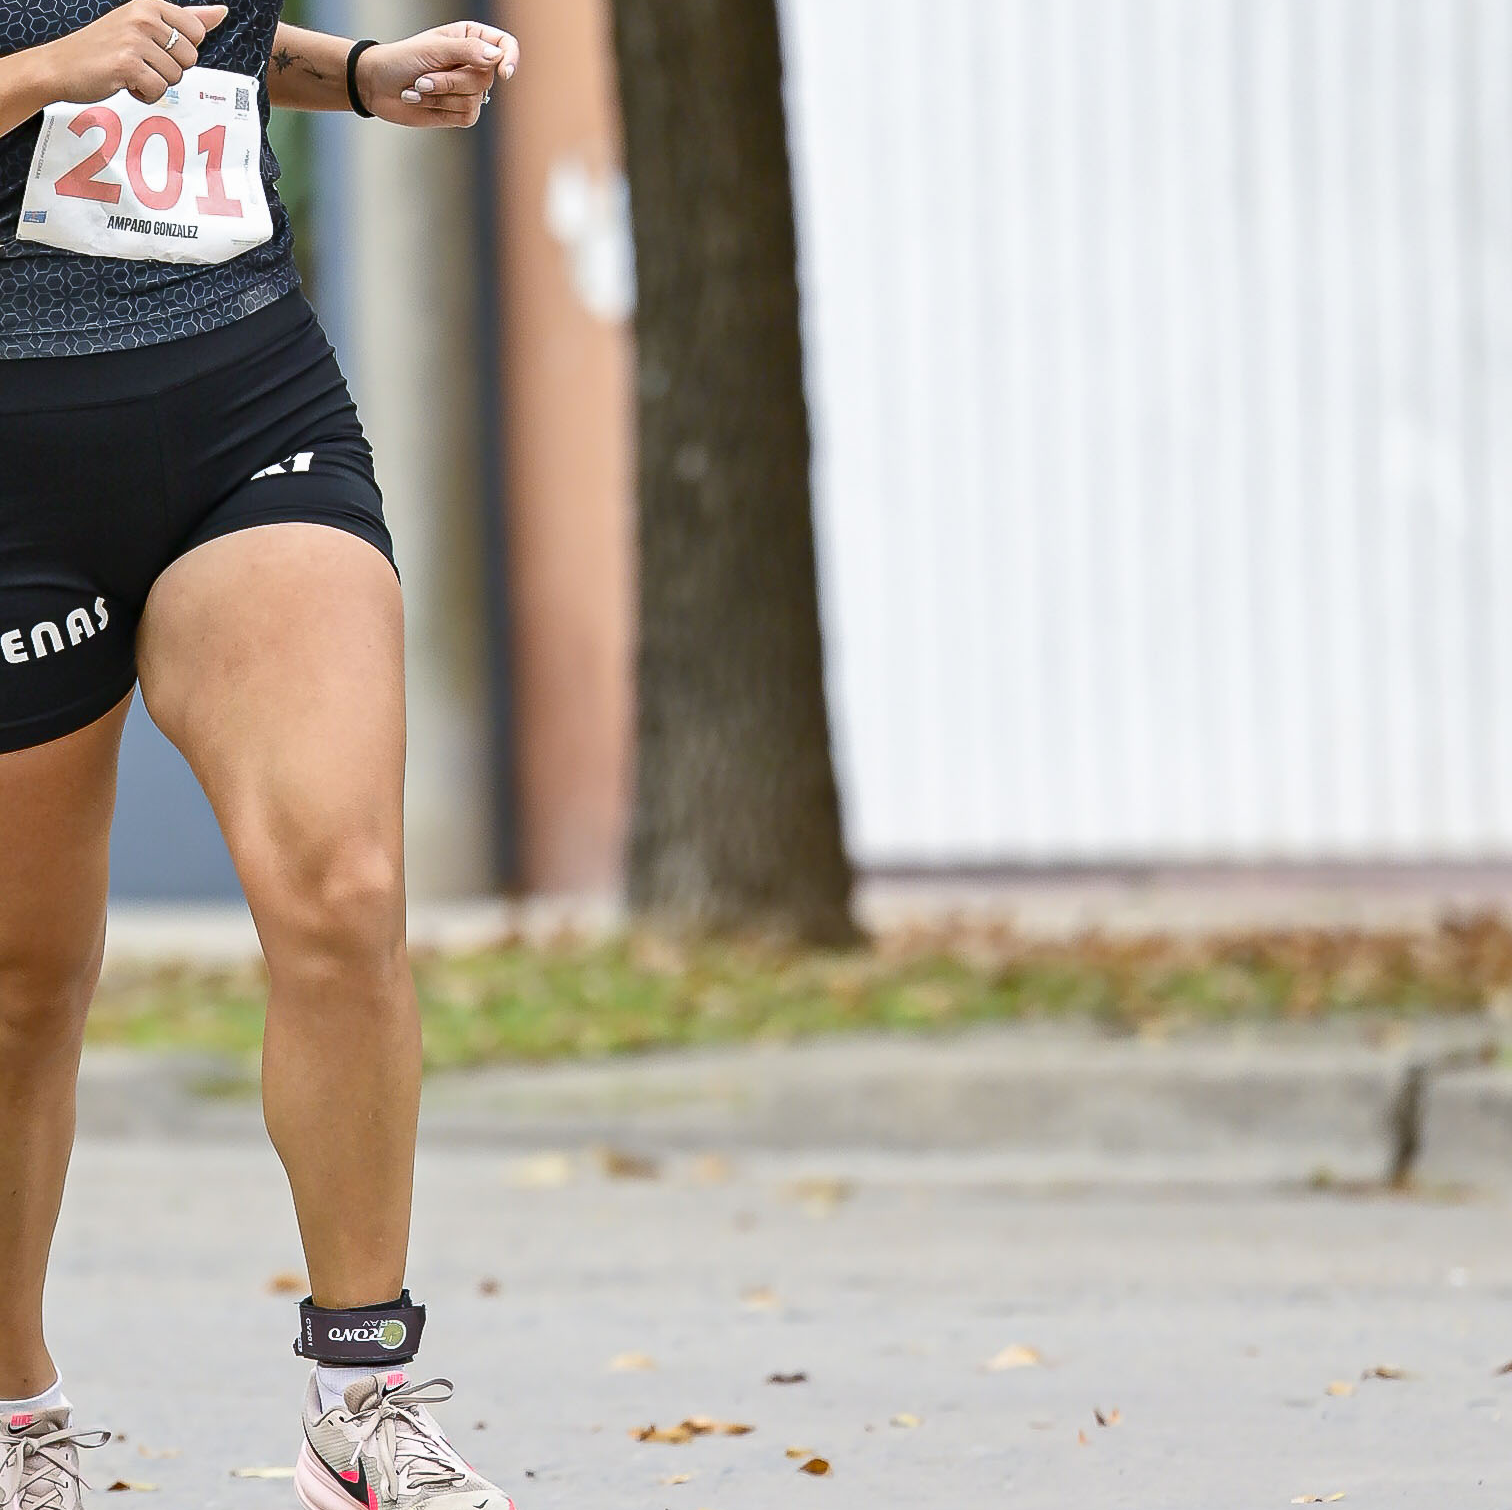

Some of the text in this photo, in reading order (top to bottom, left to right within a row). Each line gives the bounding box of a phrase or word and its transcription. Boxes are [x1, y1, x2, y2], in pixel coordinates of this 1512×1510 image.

[54, 106, 244, 219] 201
[107, 215, 199, 240] AMPARO GONZALEZ
